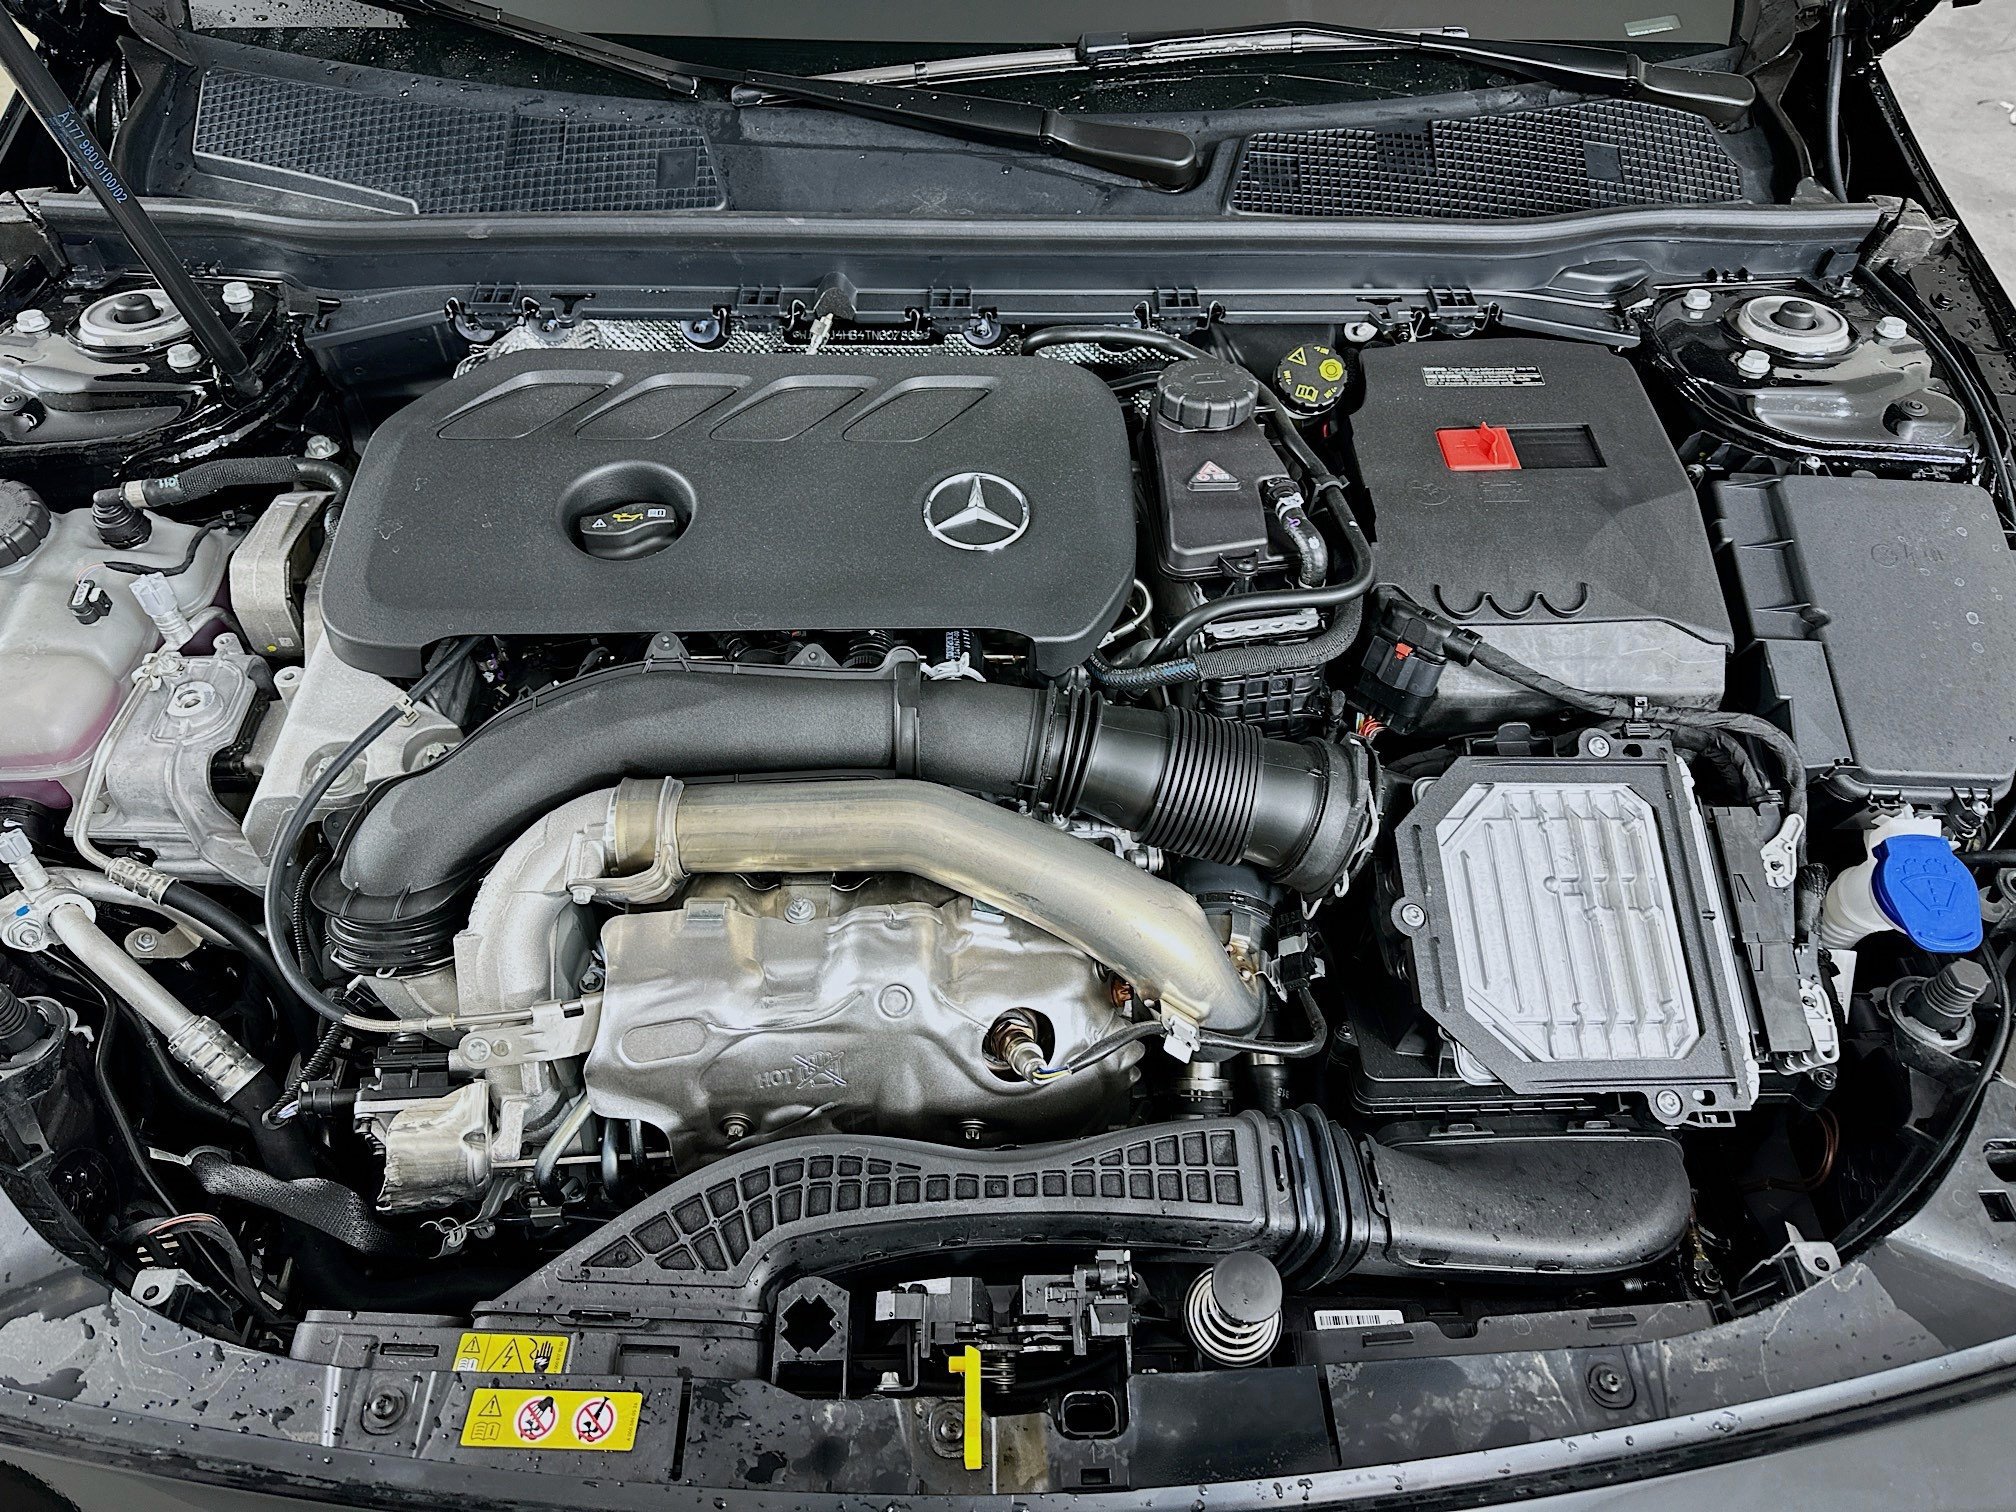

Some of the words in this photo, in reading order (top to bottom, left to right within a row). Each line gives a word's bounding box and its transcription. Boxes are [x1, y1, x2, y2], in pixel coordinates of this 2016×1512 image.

[58, 111, 85, 139] A177
[79, 139, 99, 162] 980
[94, 160, 128, 203] 0100/02
[754, 1068, 794, 1089] HOT
